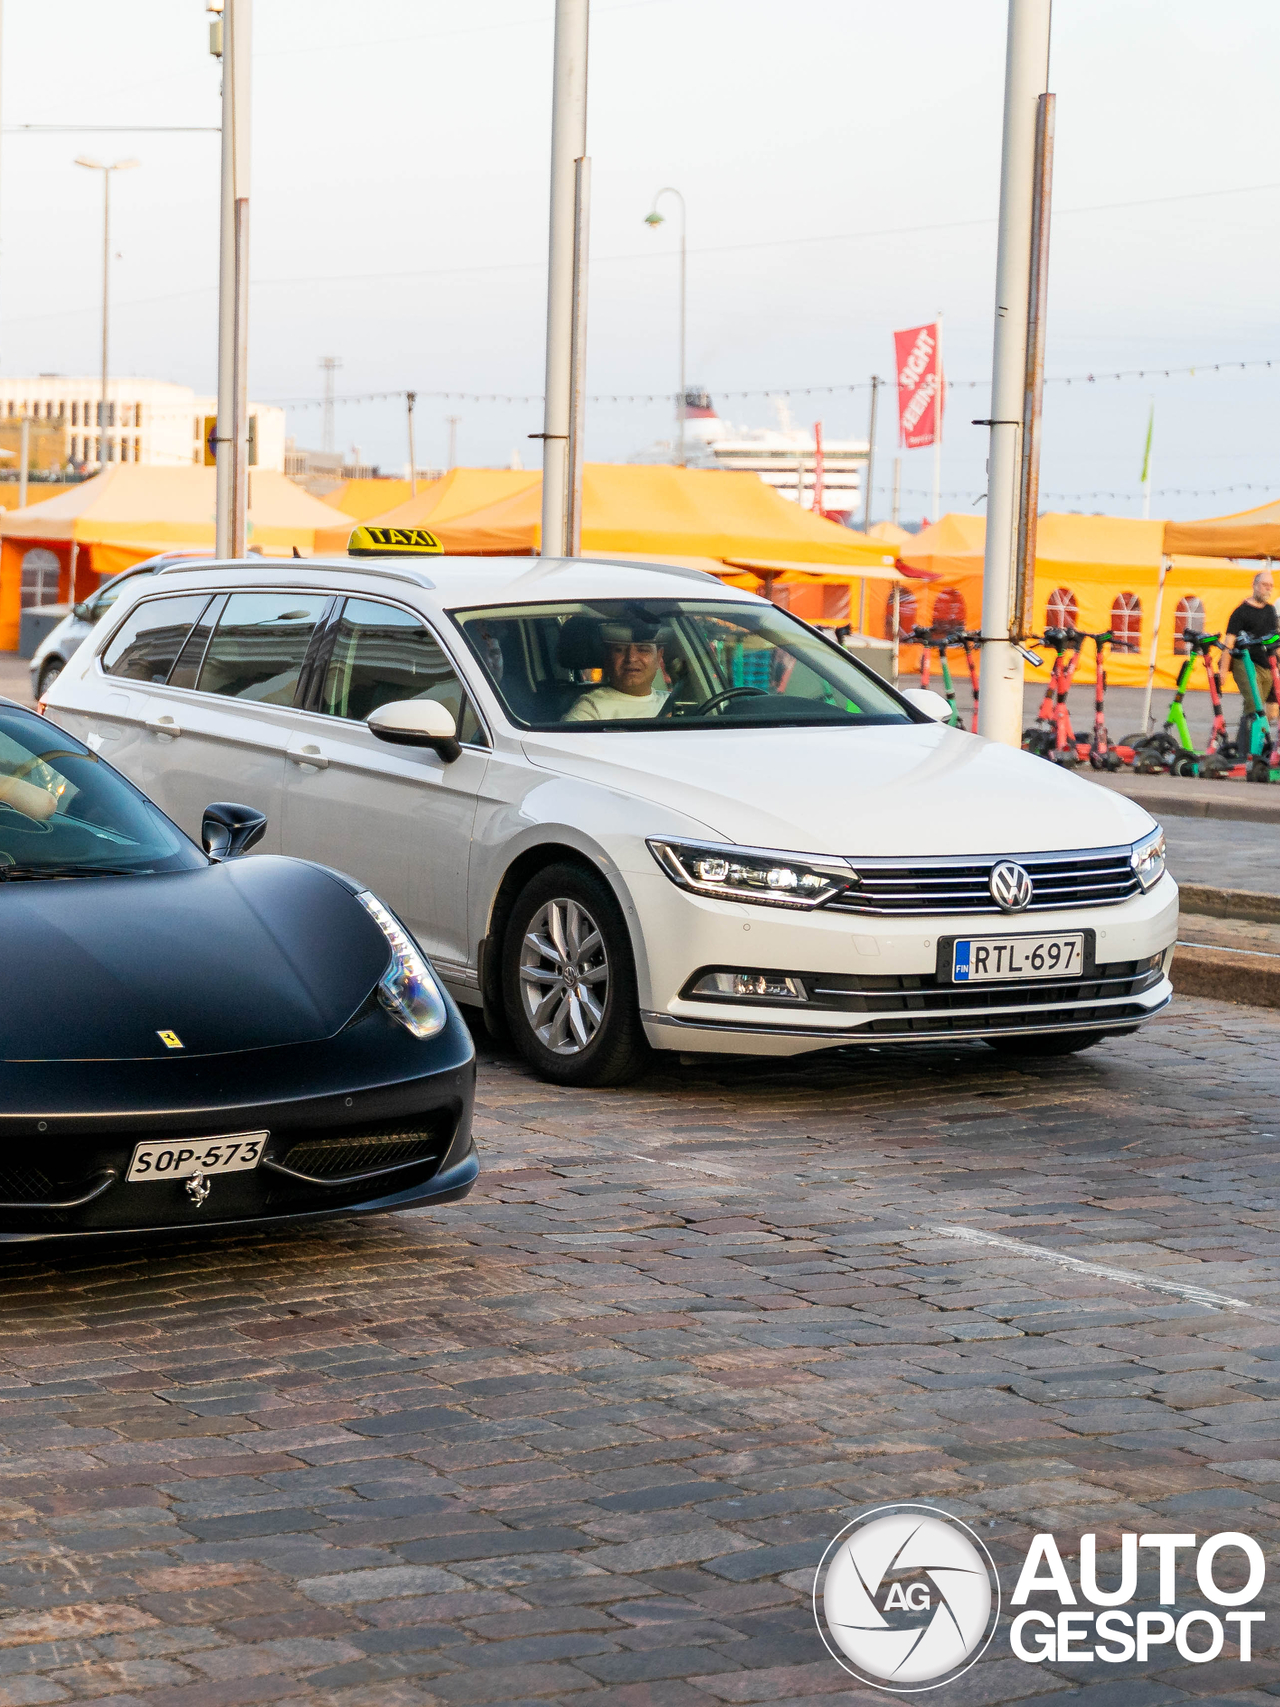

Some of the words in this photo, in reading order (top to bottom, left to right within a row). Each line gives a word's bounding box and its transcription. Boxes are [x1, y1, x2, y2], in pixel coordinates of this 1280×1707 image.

[900, 328, 935, 391] SIGHT
[367, 527, 435, 546] TAXI
[955, 964, 969, 973] FIN
[974, 941, 1077, 974] RTL-697
[134, 1141, 262, 1173] SOP-573
